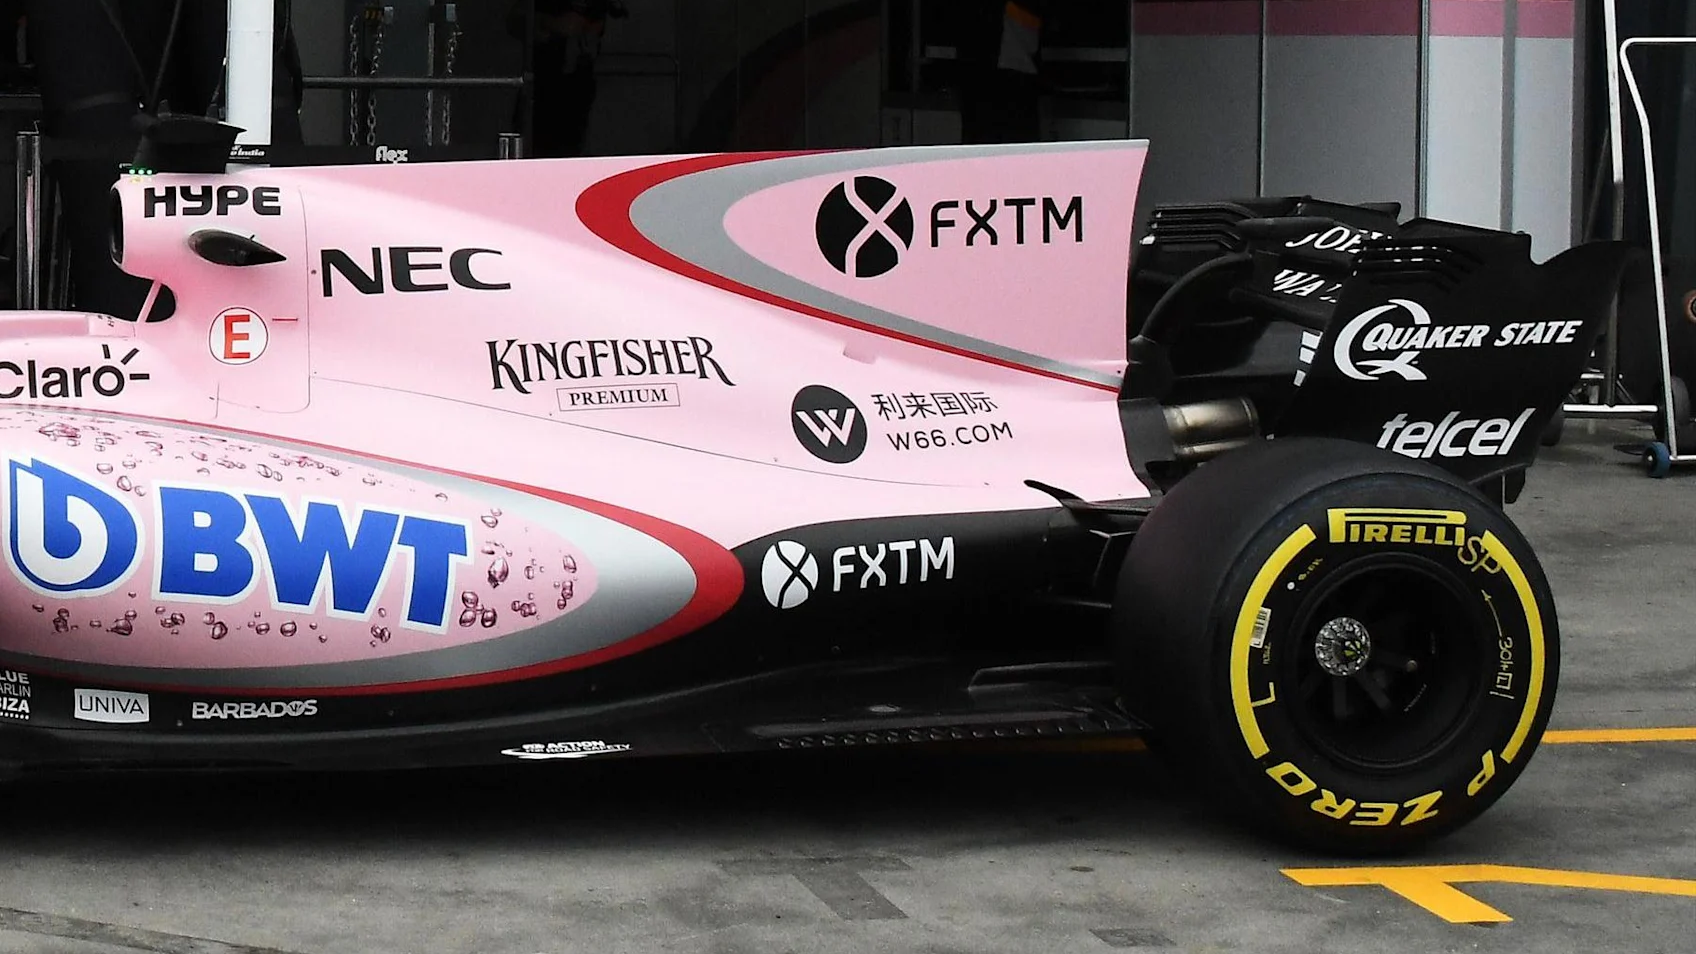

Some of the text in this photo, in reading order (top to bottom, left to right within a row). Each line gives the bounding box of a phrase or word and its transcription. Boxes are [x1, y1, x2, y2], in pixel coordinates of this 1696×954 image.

[375, 146, 409, 164] flex
[144, 184, 281, 219] HYPE
[930, 196, 1084, 248] FXTM
[319, 246, 512, 298] NEC
[223, 314, 251, 360] E
[1362, 320, 1584, 352] QUAKER STATE
[485, 336, 737, 395] KINGFISHER
[569, 388, 669, 406] PREMIUM
[872, 390, 999, 422] 利来国际
[886, 421, 1014, 452] W66.COM
[1376, 407, 1537, 459] telcel
[1327, 508, 1467, 546] PIRELLI
[156, 485, 469, 629] BWT
[833, 536, 956, 592] FXTM
[79, 694, 145, 715] UNIVA
[192, 699, 318, 719] BARBADOS
[1264, 749, 1495, 827] P ZERO
